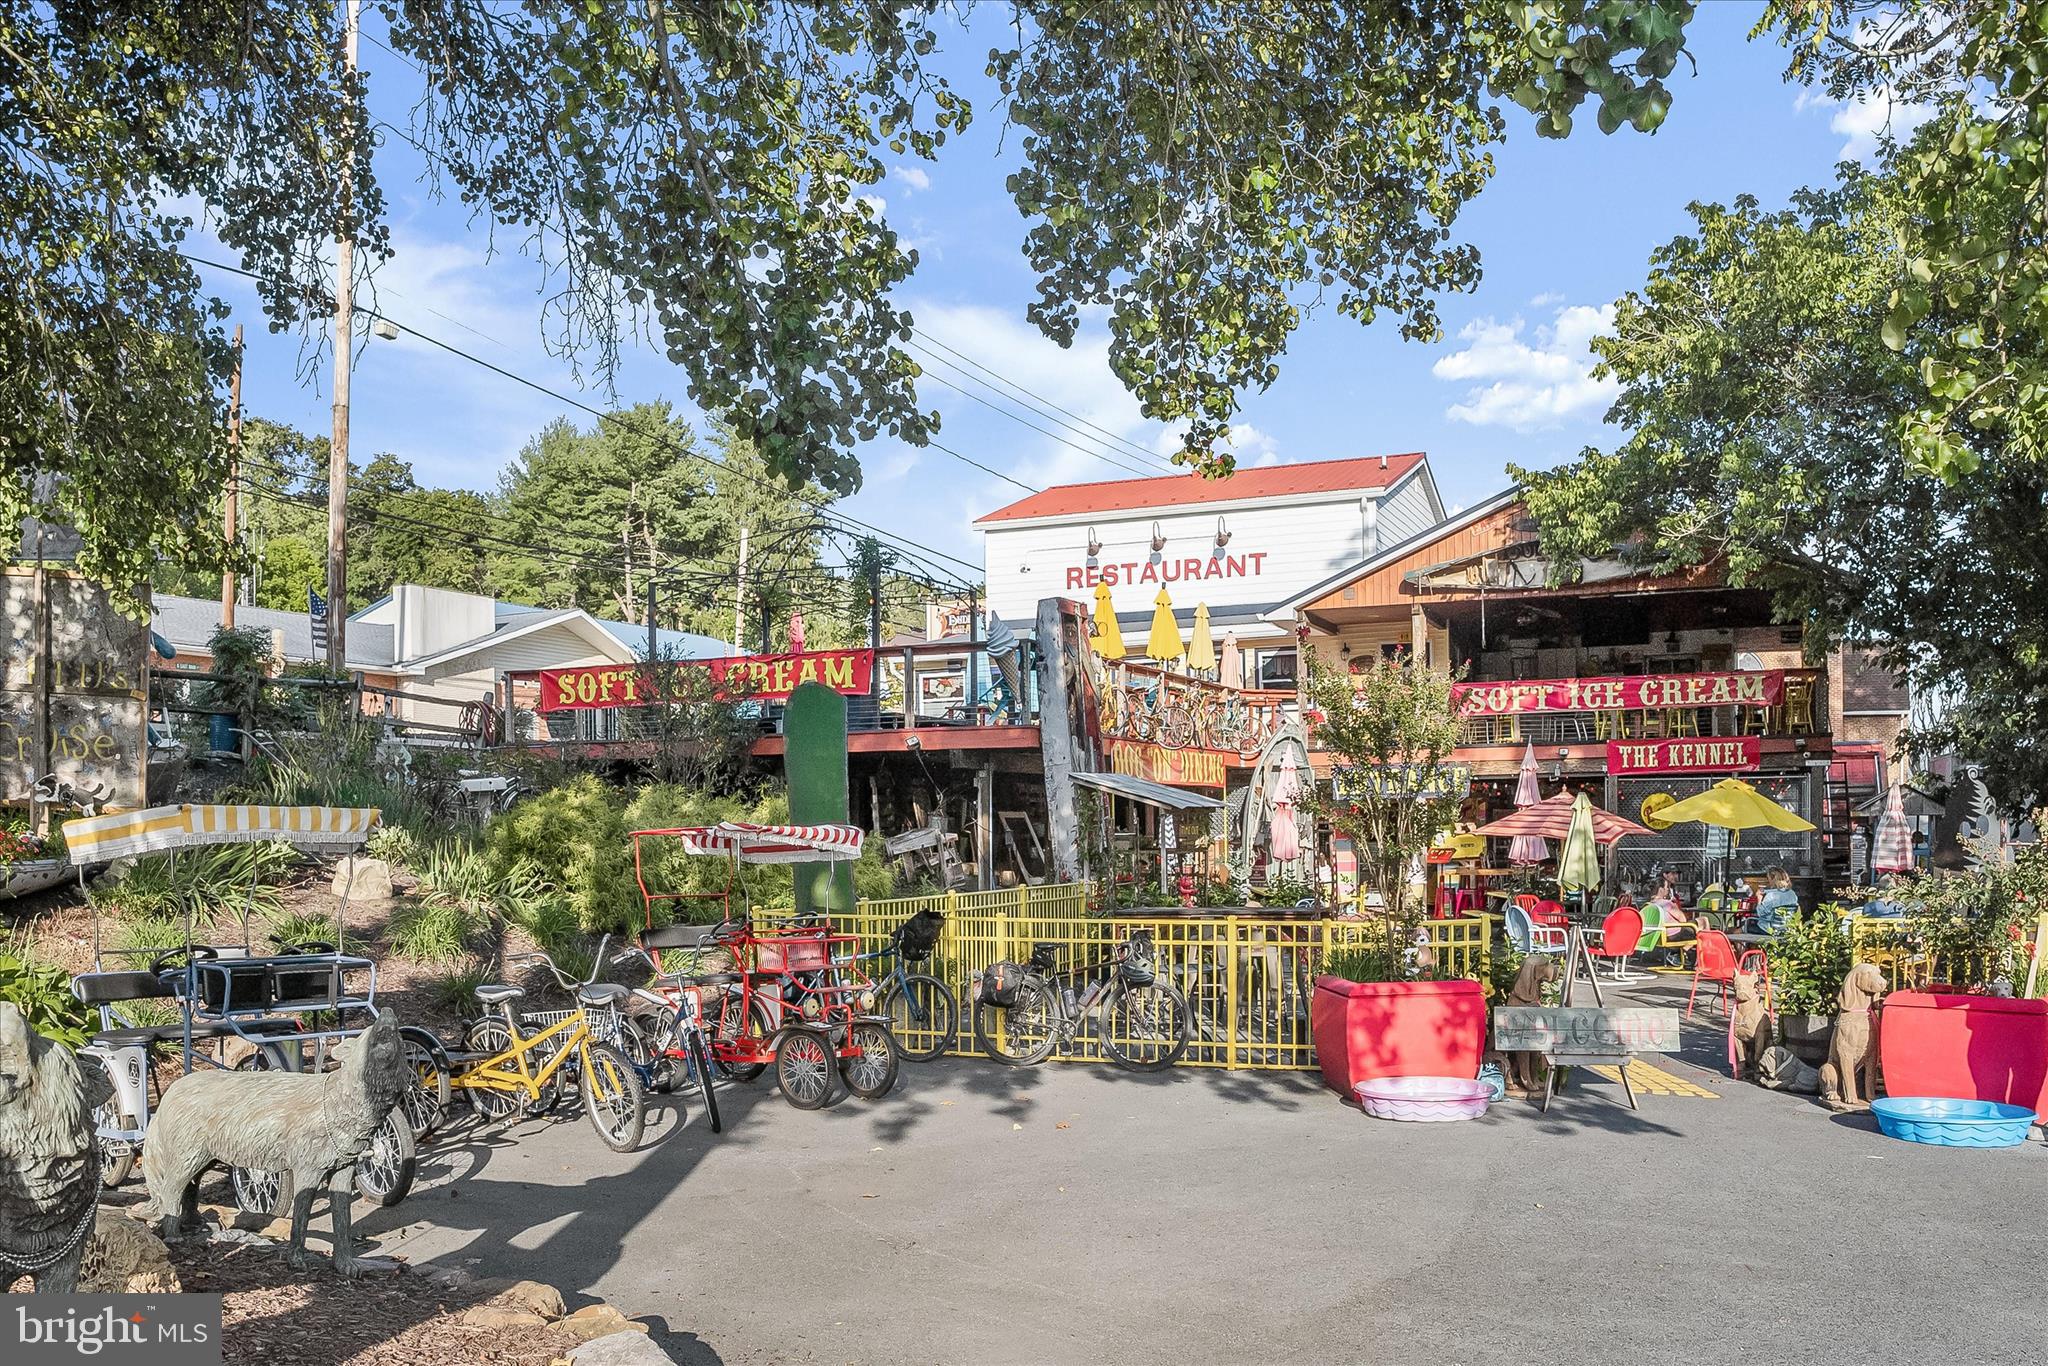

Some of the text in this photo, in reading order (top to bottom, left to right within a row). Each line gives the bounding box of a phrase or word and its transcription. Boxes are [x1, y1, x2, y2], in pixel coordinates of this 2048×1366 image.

[1066, 552, 1268, 589] RESTAURANT
[558, 669, 638, 704] SOFT
[724, 656, 856, 695] CREAM
[1468, 674, 1767, 714] SOFT ICE CREAM
[1179, 749, 1226, 785] DINING
[1618, 742, 1747, 768] THE KENNEL
